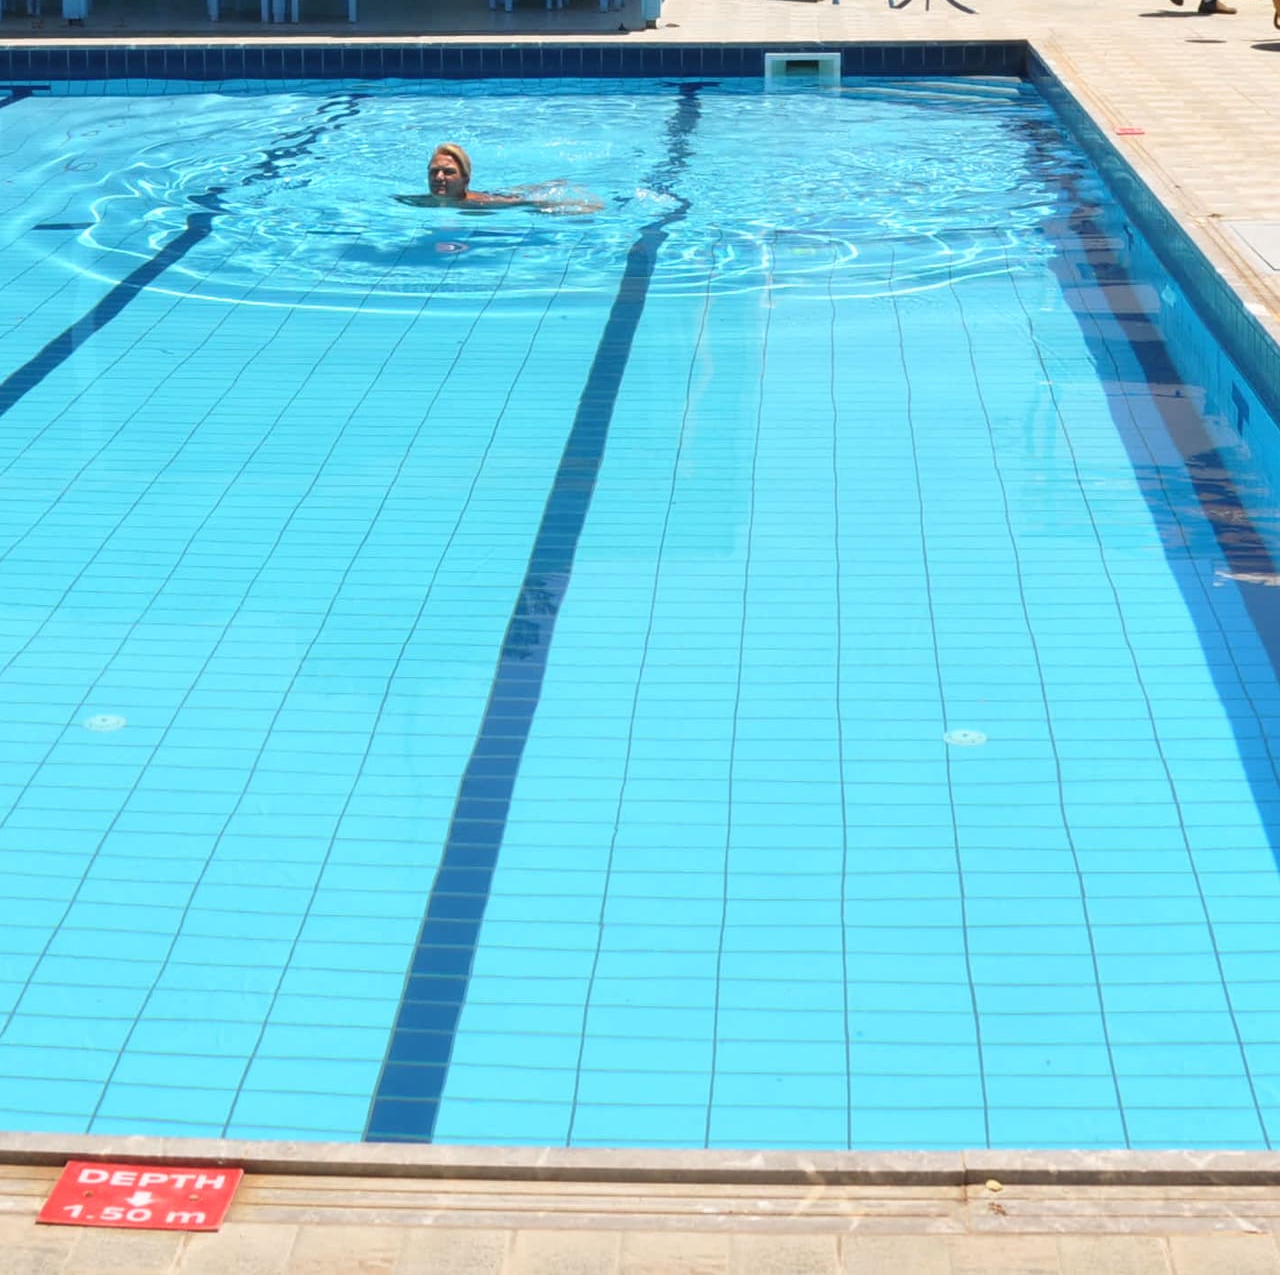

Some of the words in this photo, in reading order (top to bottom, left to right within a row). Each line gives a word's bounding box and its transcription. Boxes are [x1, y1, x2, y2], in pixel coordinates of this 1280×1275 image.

[77, 1168, 225, 1190] DEPTH
[63, 1204, 153, 1223] 1.50
[165, 1211, 206, 1224] m
